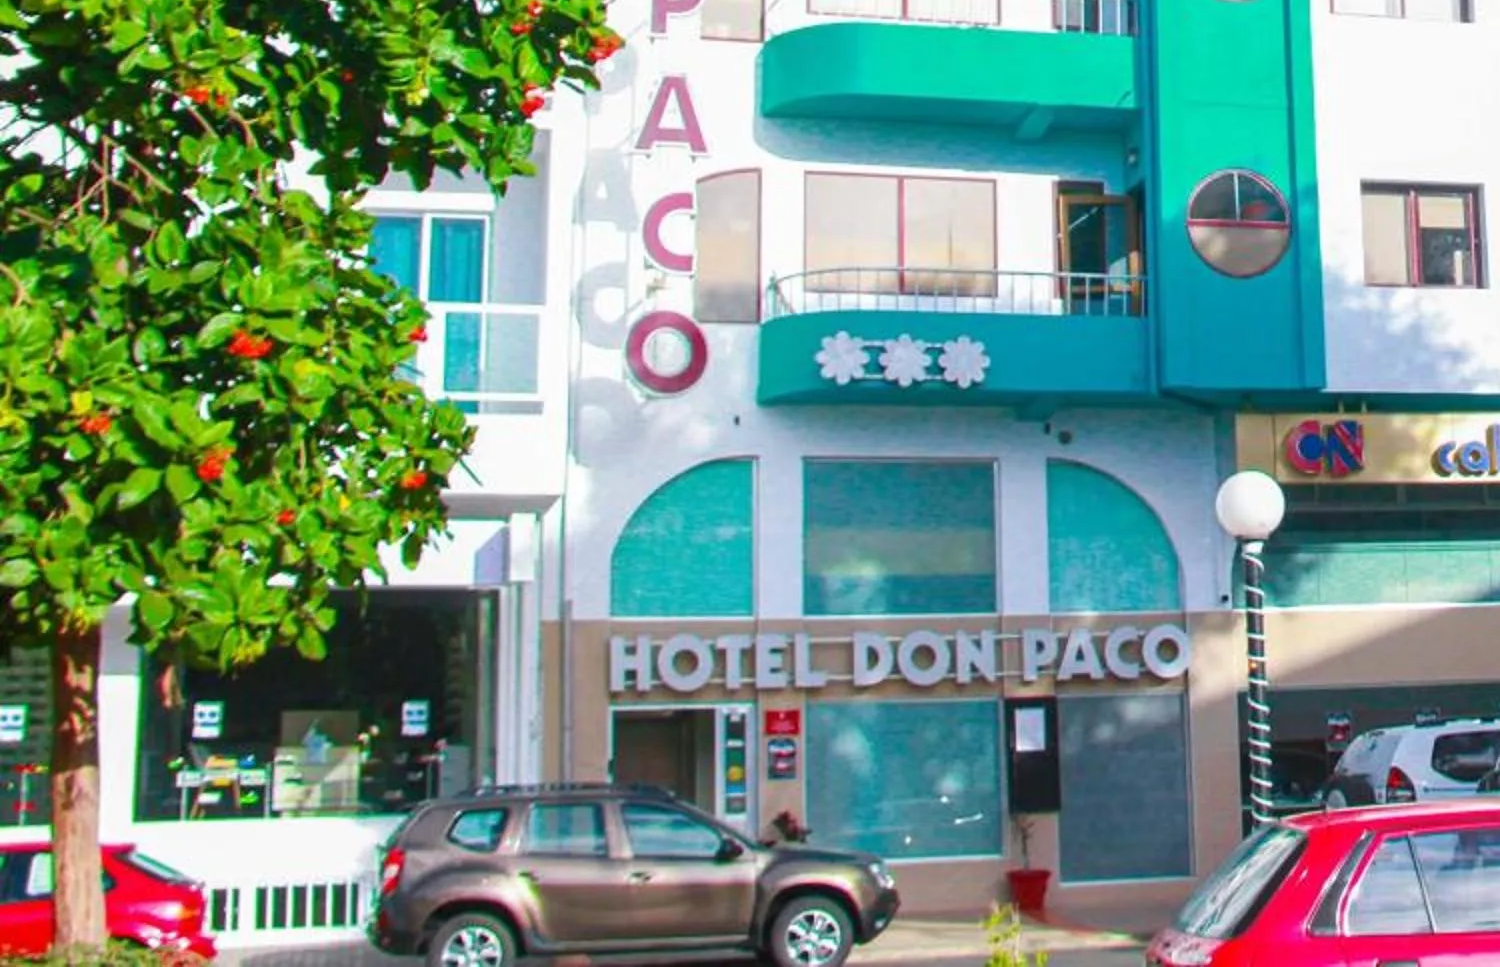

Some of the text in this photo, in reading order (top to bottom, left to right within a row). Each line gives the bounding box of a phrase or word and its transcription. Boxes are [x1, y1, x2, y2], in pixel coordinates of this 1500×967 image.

[1285, 419, 1365, 476] CN
[608, 623, 1192, 693] HOTEL DON PACO
